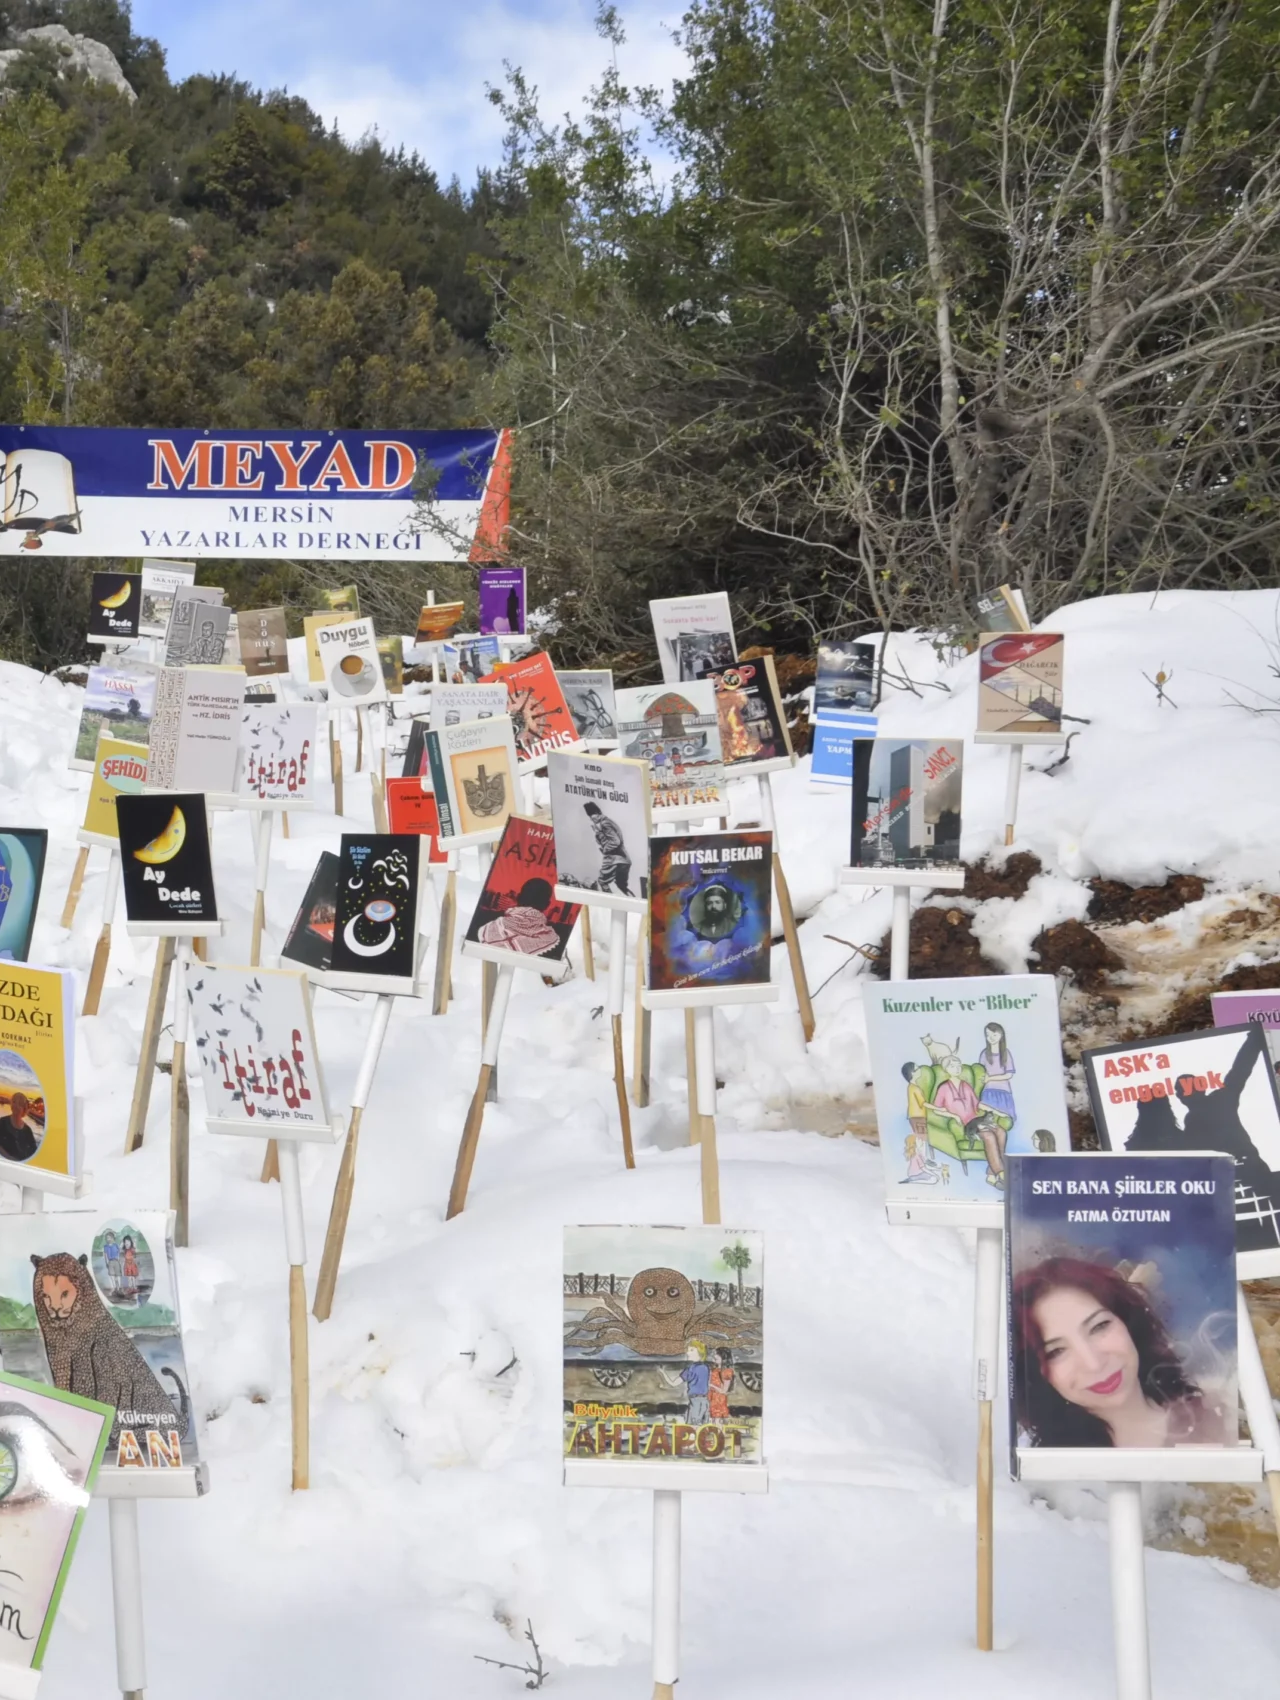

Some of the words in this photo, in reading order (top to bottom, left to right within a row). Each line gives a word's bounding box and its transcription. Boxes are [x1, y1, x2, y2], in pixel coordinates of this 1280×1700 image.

[147, 440, 416, 492] MEYAD
[228, 502, 334, 523] MERSİN
[140, 530, 287, 549] YAZARLAR
[102, 608, 116, 618] Ay
[108, 619, 132, 627] Dede
[320, 626, 368, 644] Duygu
[212, 711, 231, 720] İDRİS
[565, 783, 607, 800] ATATÜRK'ÜN
[671, 848, 719, 866] KUTSAL
[721, 846, 763, 862] BEKAR
[143, 867, 166, 884] Ay
[158, 887, 201, 902] Dede
[882, 997, 954, 1014] Kuzenler
[958, 999, 976, 1012] ve
[1, 1032, 32, 1044] KORKMAZ
[1103, 1052, 1170, 1078] AŞK'a
[1108, 1075, 1174, 1105] engel
[1179, 1069, 1224, 1094] yok
[294, 1110, 314, 1121] Duru
[1032, 1180, 1063, 1195] SEN
[1066, 1180, 1110, 1195] BANA
[1114, 1175, 1178, 1198] ŞİİRLER
[1181, 1180, 1216, 1196] OKU
[1068, 1210, 1109, 1222] FATMA
[1112, 1207, 1171, 1223] ÖZTUTAN
[117, 1409, 176, 1426] Kükreyen
[574, 1403, 638, 1419] Büyük
[567, 1420, 749, 1459] AHTAPOT
[116, 1430, 183, 1468] AN
